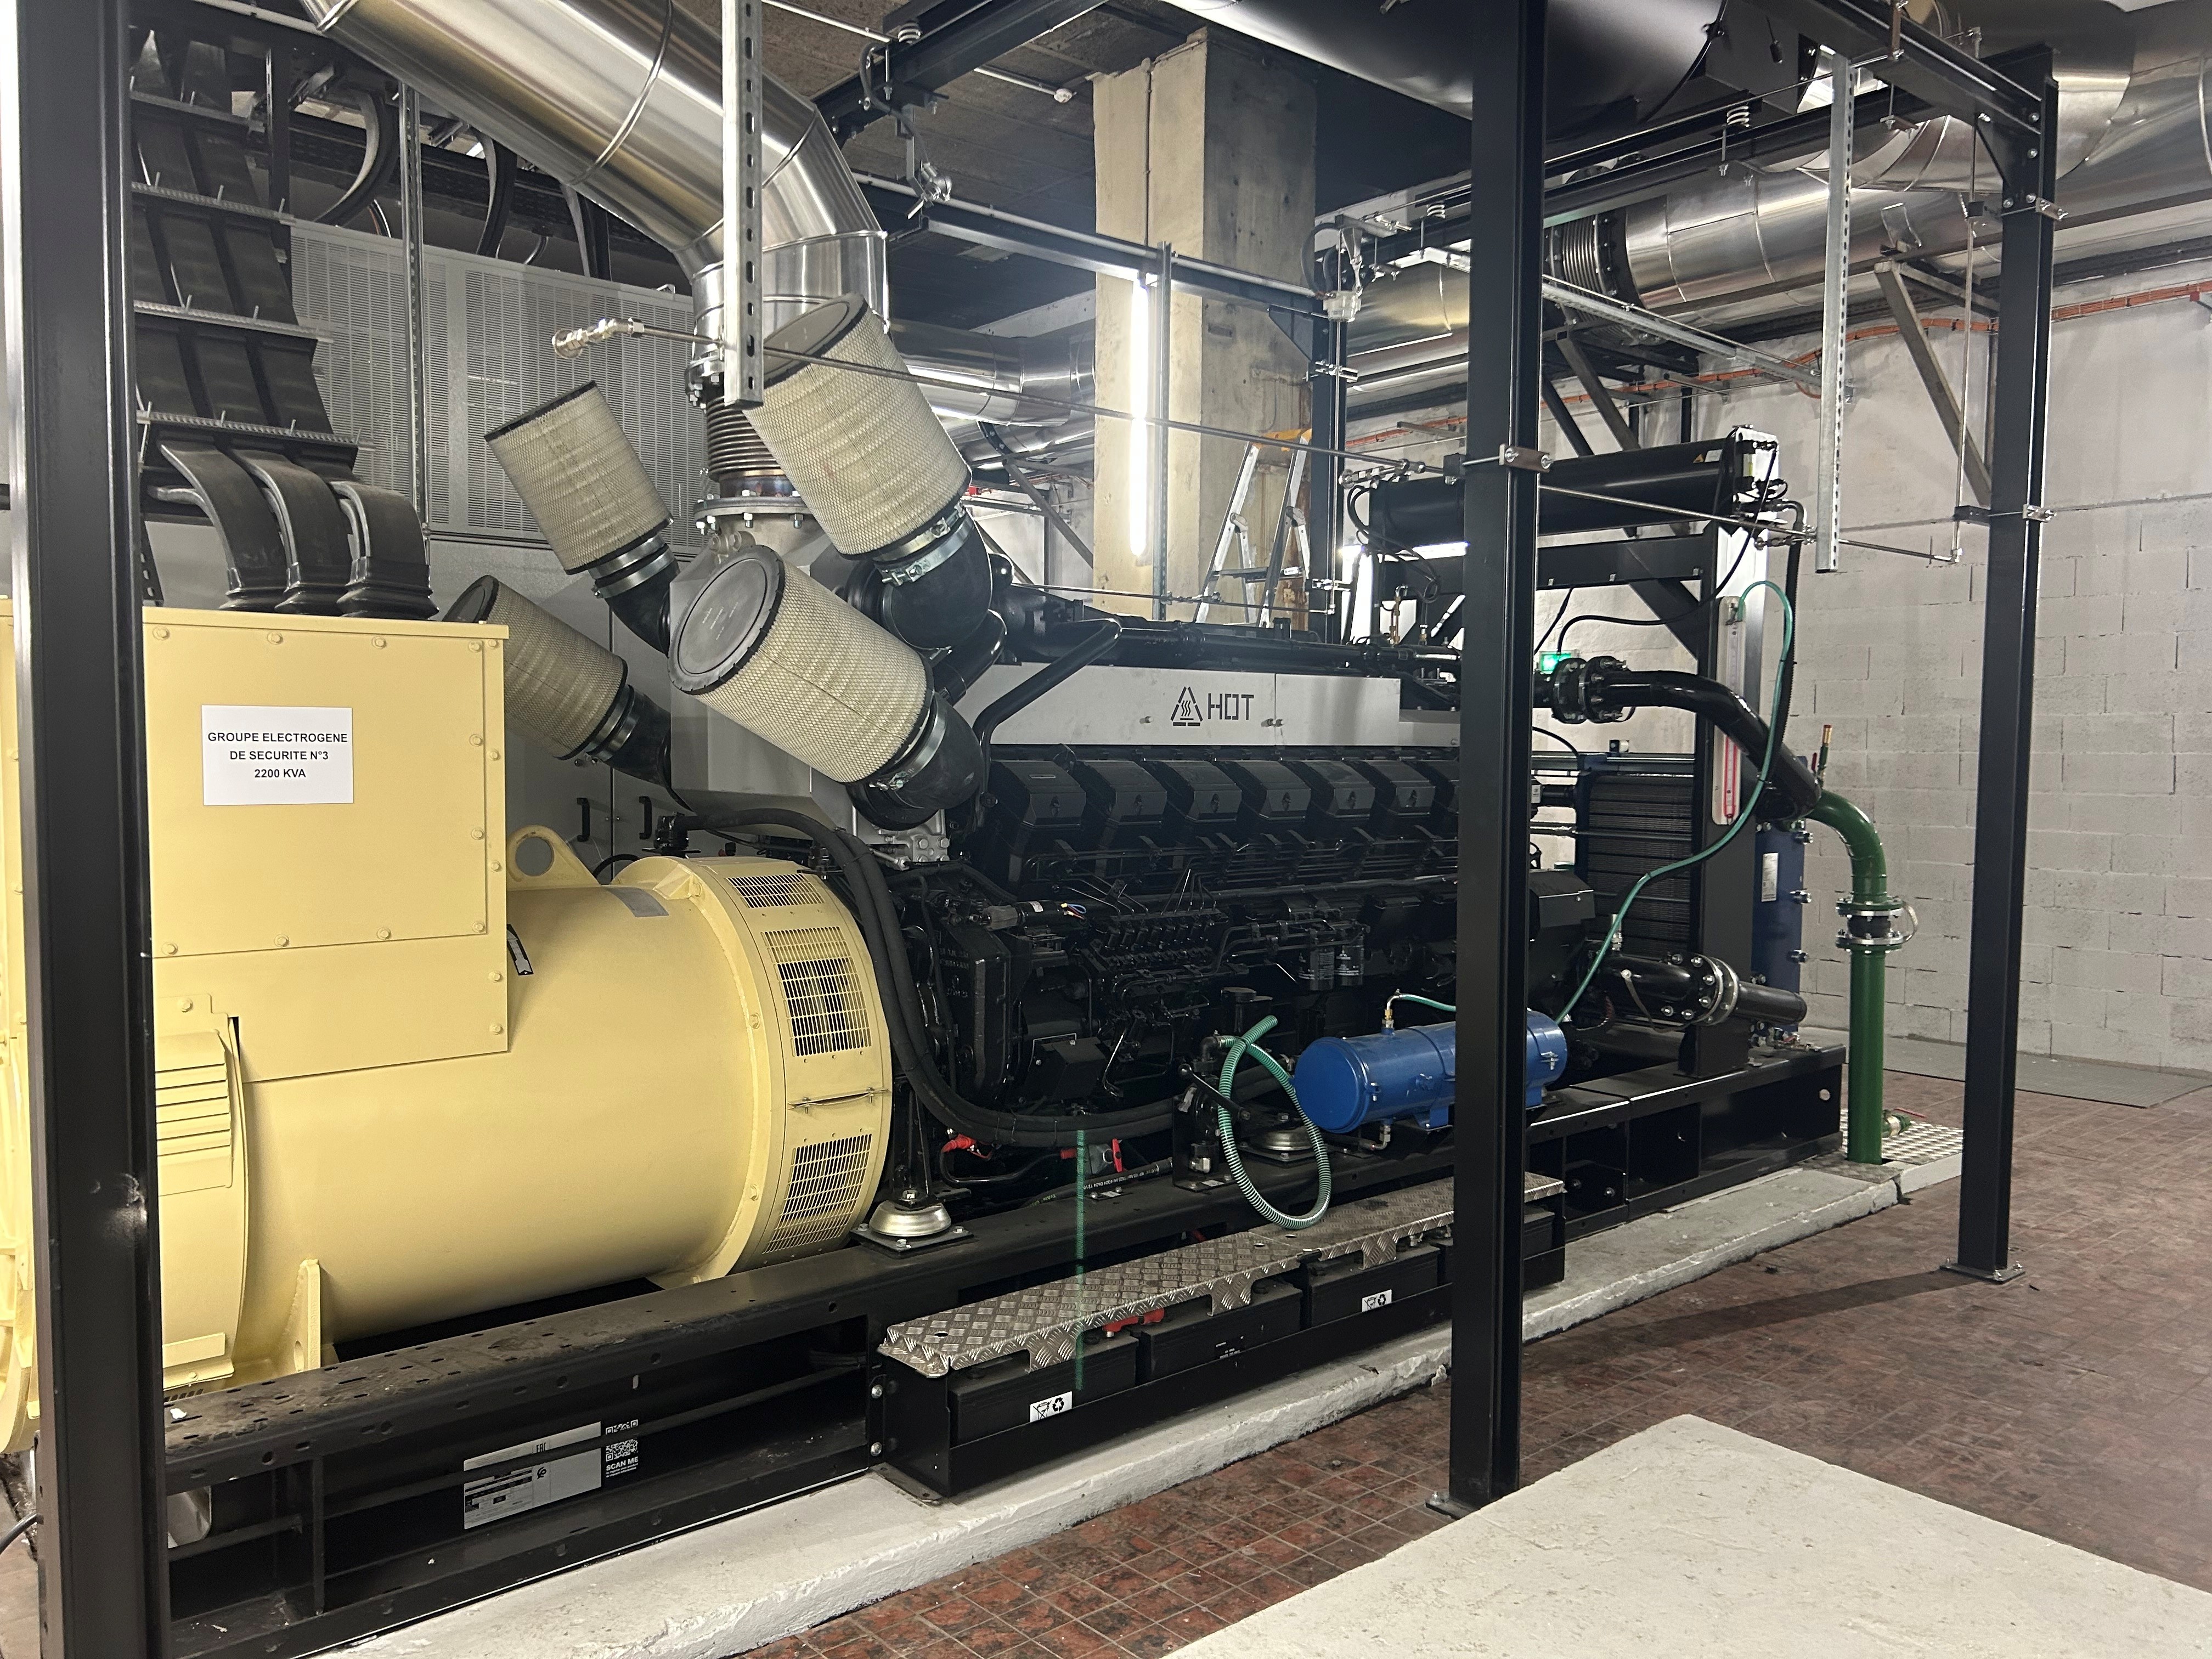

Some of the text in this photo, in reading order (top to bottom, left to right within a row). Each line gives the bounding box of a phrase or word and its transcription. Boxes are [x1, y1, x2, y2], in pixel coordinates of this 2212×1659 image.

[1208, 693, 1254, 720] HOT
[208, 732, 348, 742] GROUPE ELECTROGENE
[230, 751, 329, 760] DE SECURITE N°3
[255, 769, 306, 778] 2200 KVA
[606, 1460, 626, 1471] SCAN
[628, 1456, 639, 1465] ME
